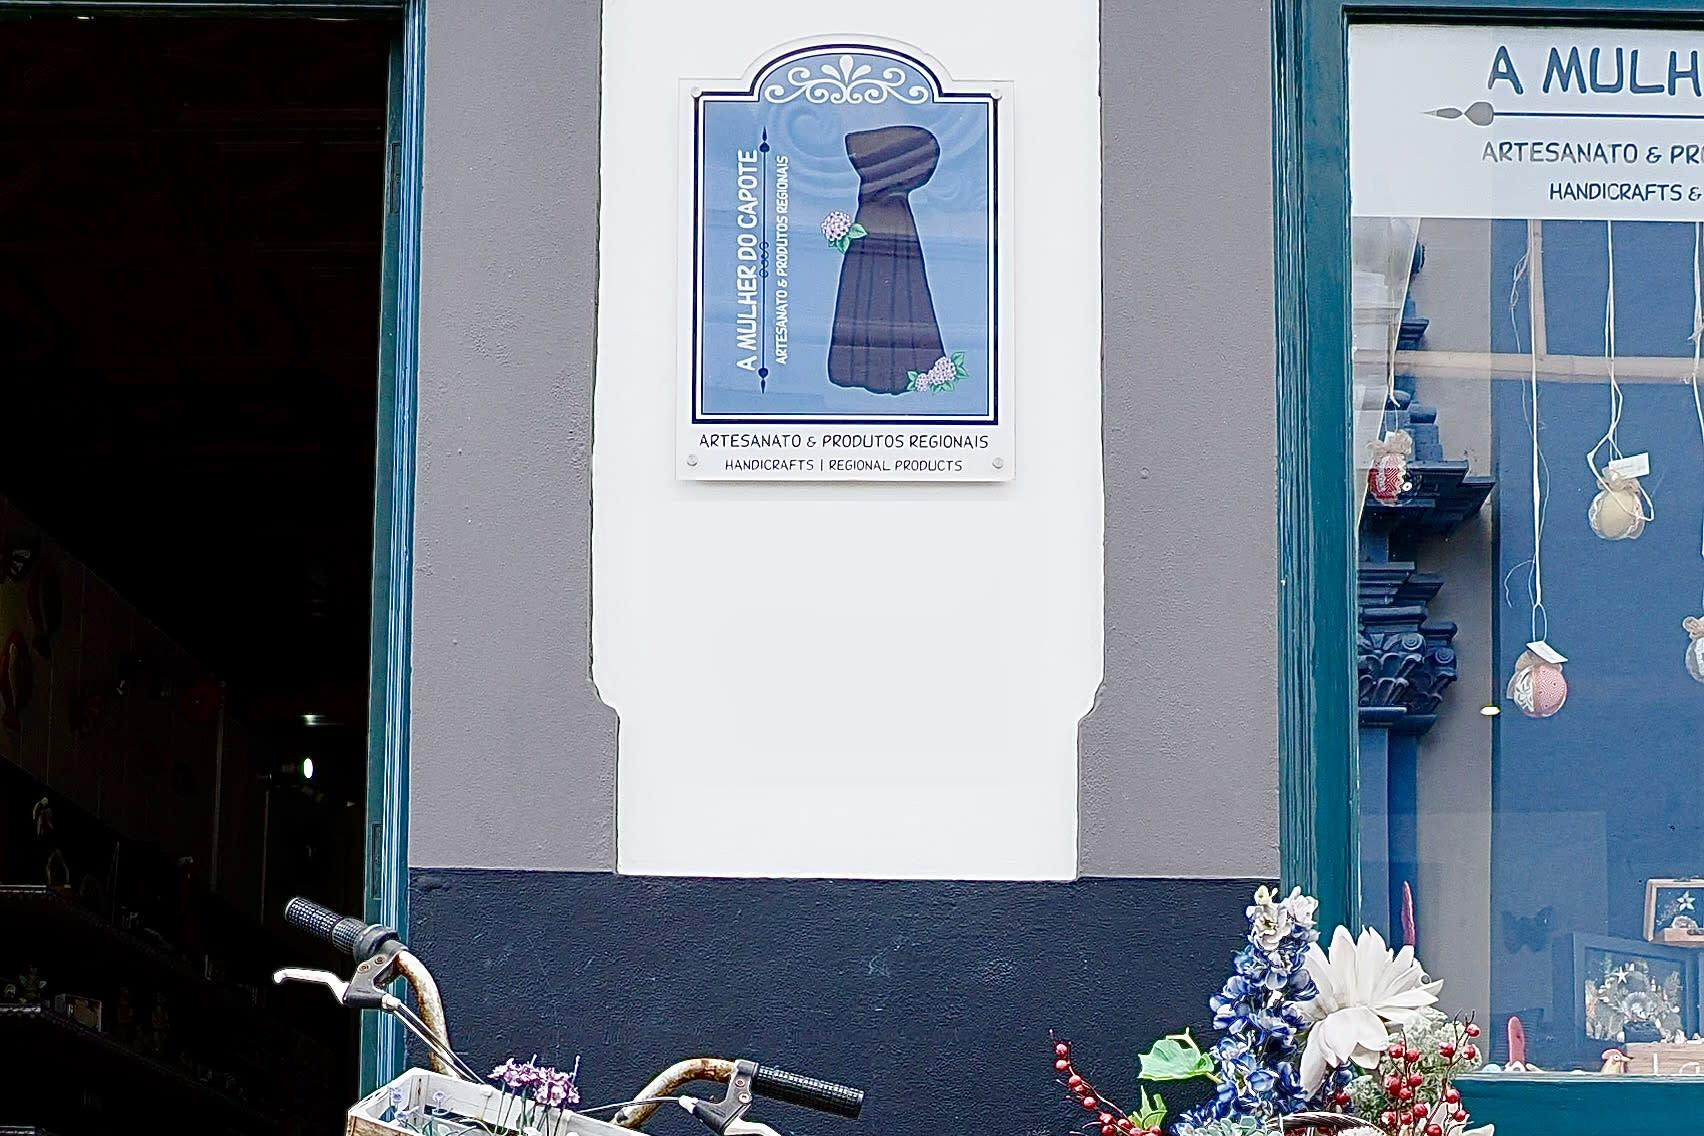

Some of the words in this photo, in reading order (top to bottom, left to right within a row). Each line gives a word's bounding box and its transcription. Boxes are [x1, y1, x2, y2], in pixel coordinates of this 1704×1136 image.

[1488, 46, 1523, 95] A
[1482, 141, 1638, 165] ARTESANATO
[1646, 146, 1662, 164] &
[737, 149, 759, 229] CAPOTE
[776, 155, 789, 214] REGIONAIS
[1550, 182, 1682, 202] HANDICRAFTS
[1688, 186, 1702, 202] &
[737, 233, 758, 260] DO
[776, 215, 789, 277] PRODUTOS
[777, 278, 788, 288] &
[736, 264, 758, 351] MULHER
[775, 289, 788, 365] ARTESANATO
[736, 355, 758, 371] A
[699, 434, 801, 449] ARTESANATO
[806, 435, 816, 448] &
[822, 434, 904, 449] PRODUTOS
[908, 434, 989, 449] REGIONAIS
[725, 459, 814, 472] HANDICRAFTS
[828, 459, 891, 472] REGIONAL
[895, 460, 963, 473] PRODUCTS
